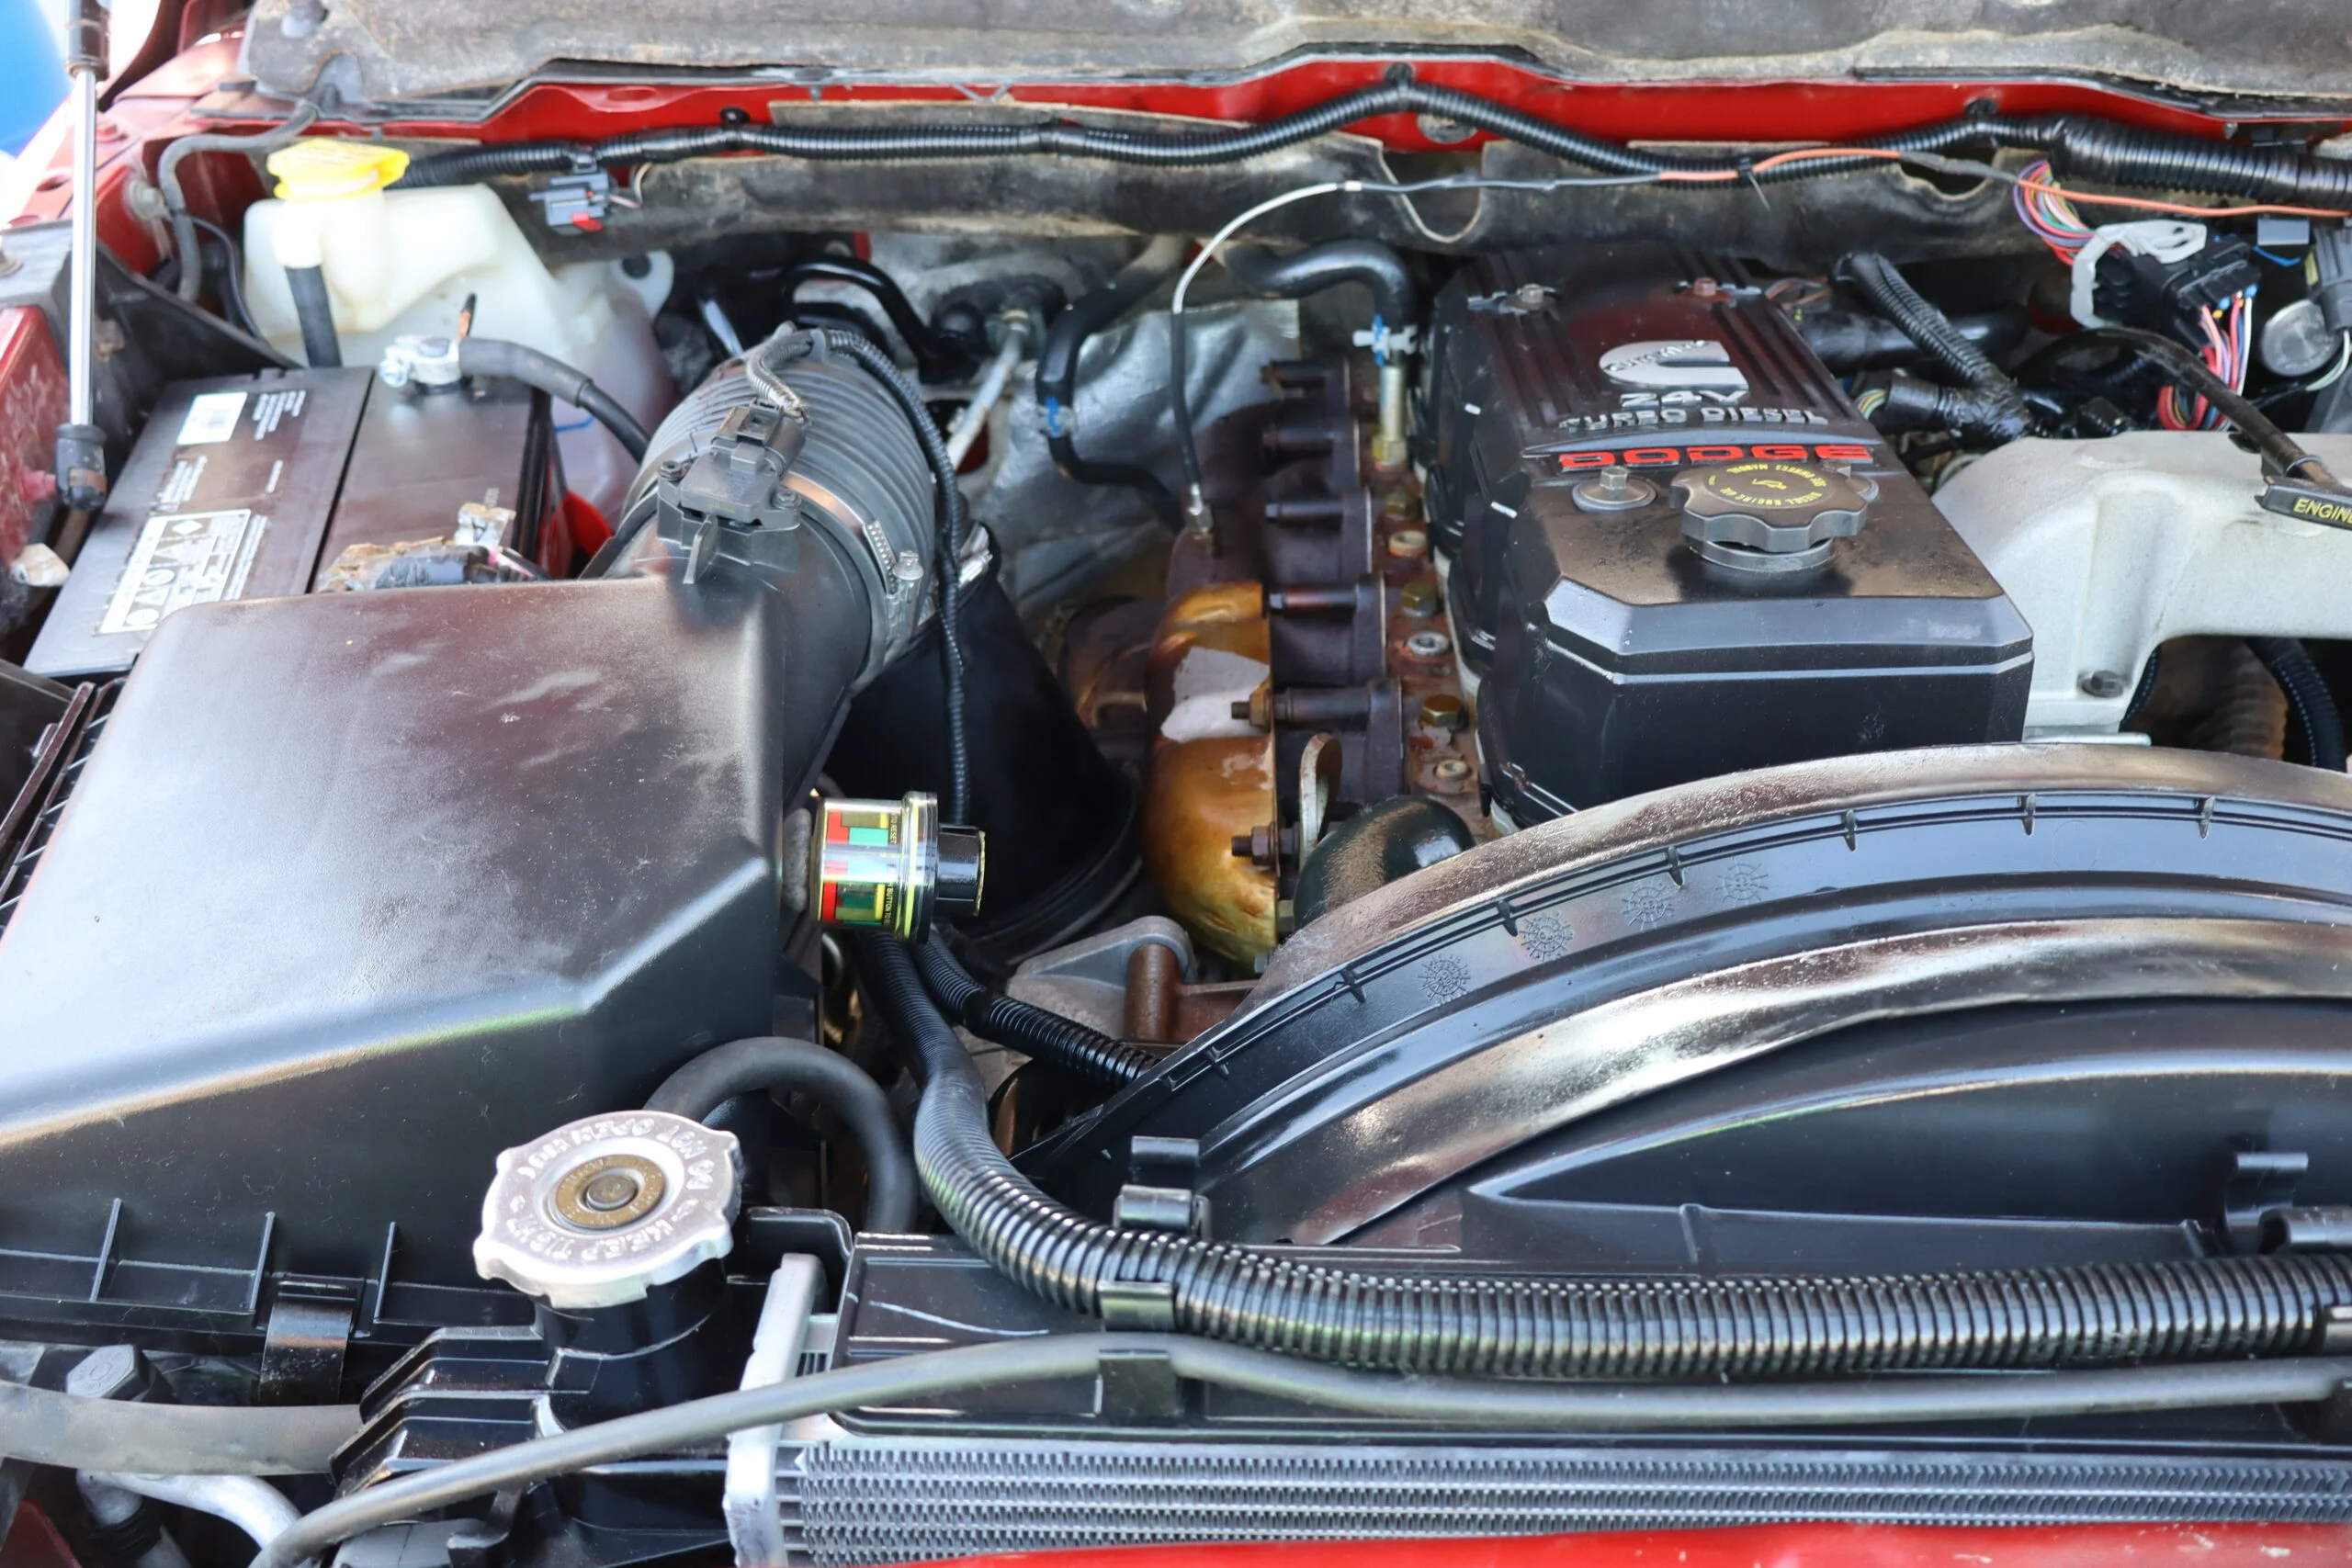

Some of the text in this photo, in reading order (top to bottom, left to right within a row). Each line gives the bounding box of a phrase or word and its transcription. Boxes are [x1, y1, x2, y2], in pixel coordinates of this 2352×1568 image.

[1620, 389, 1748, 409] 24V
[1559, 406, 1829, 434] TURBO DIESEL
[1559, 444, 1874, 472] DODGE
[580, 1219, 674, 1261] KEEP
